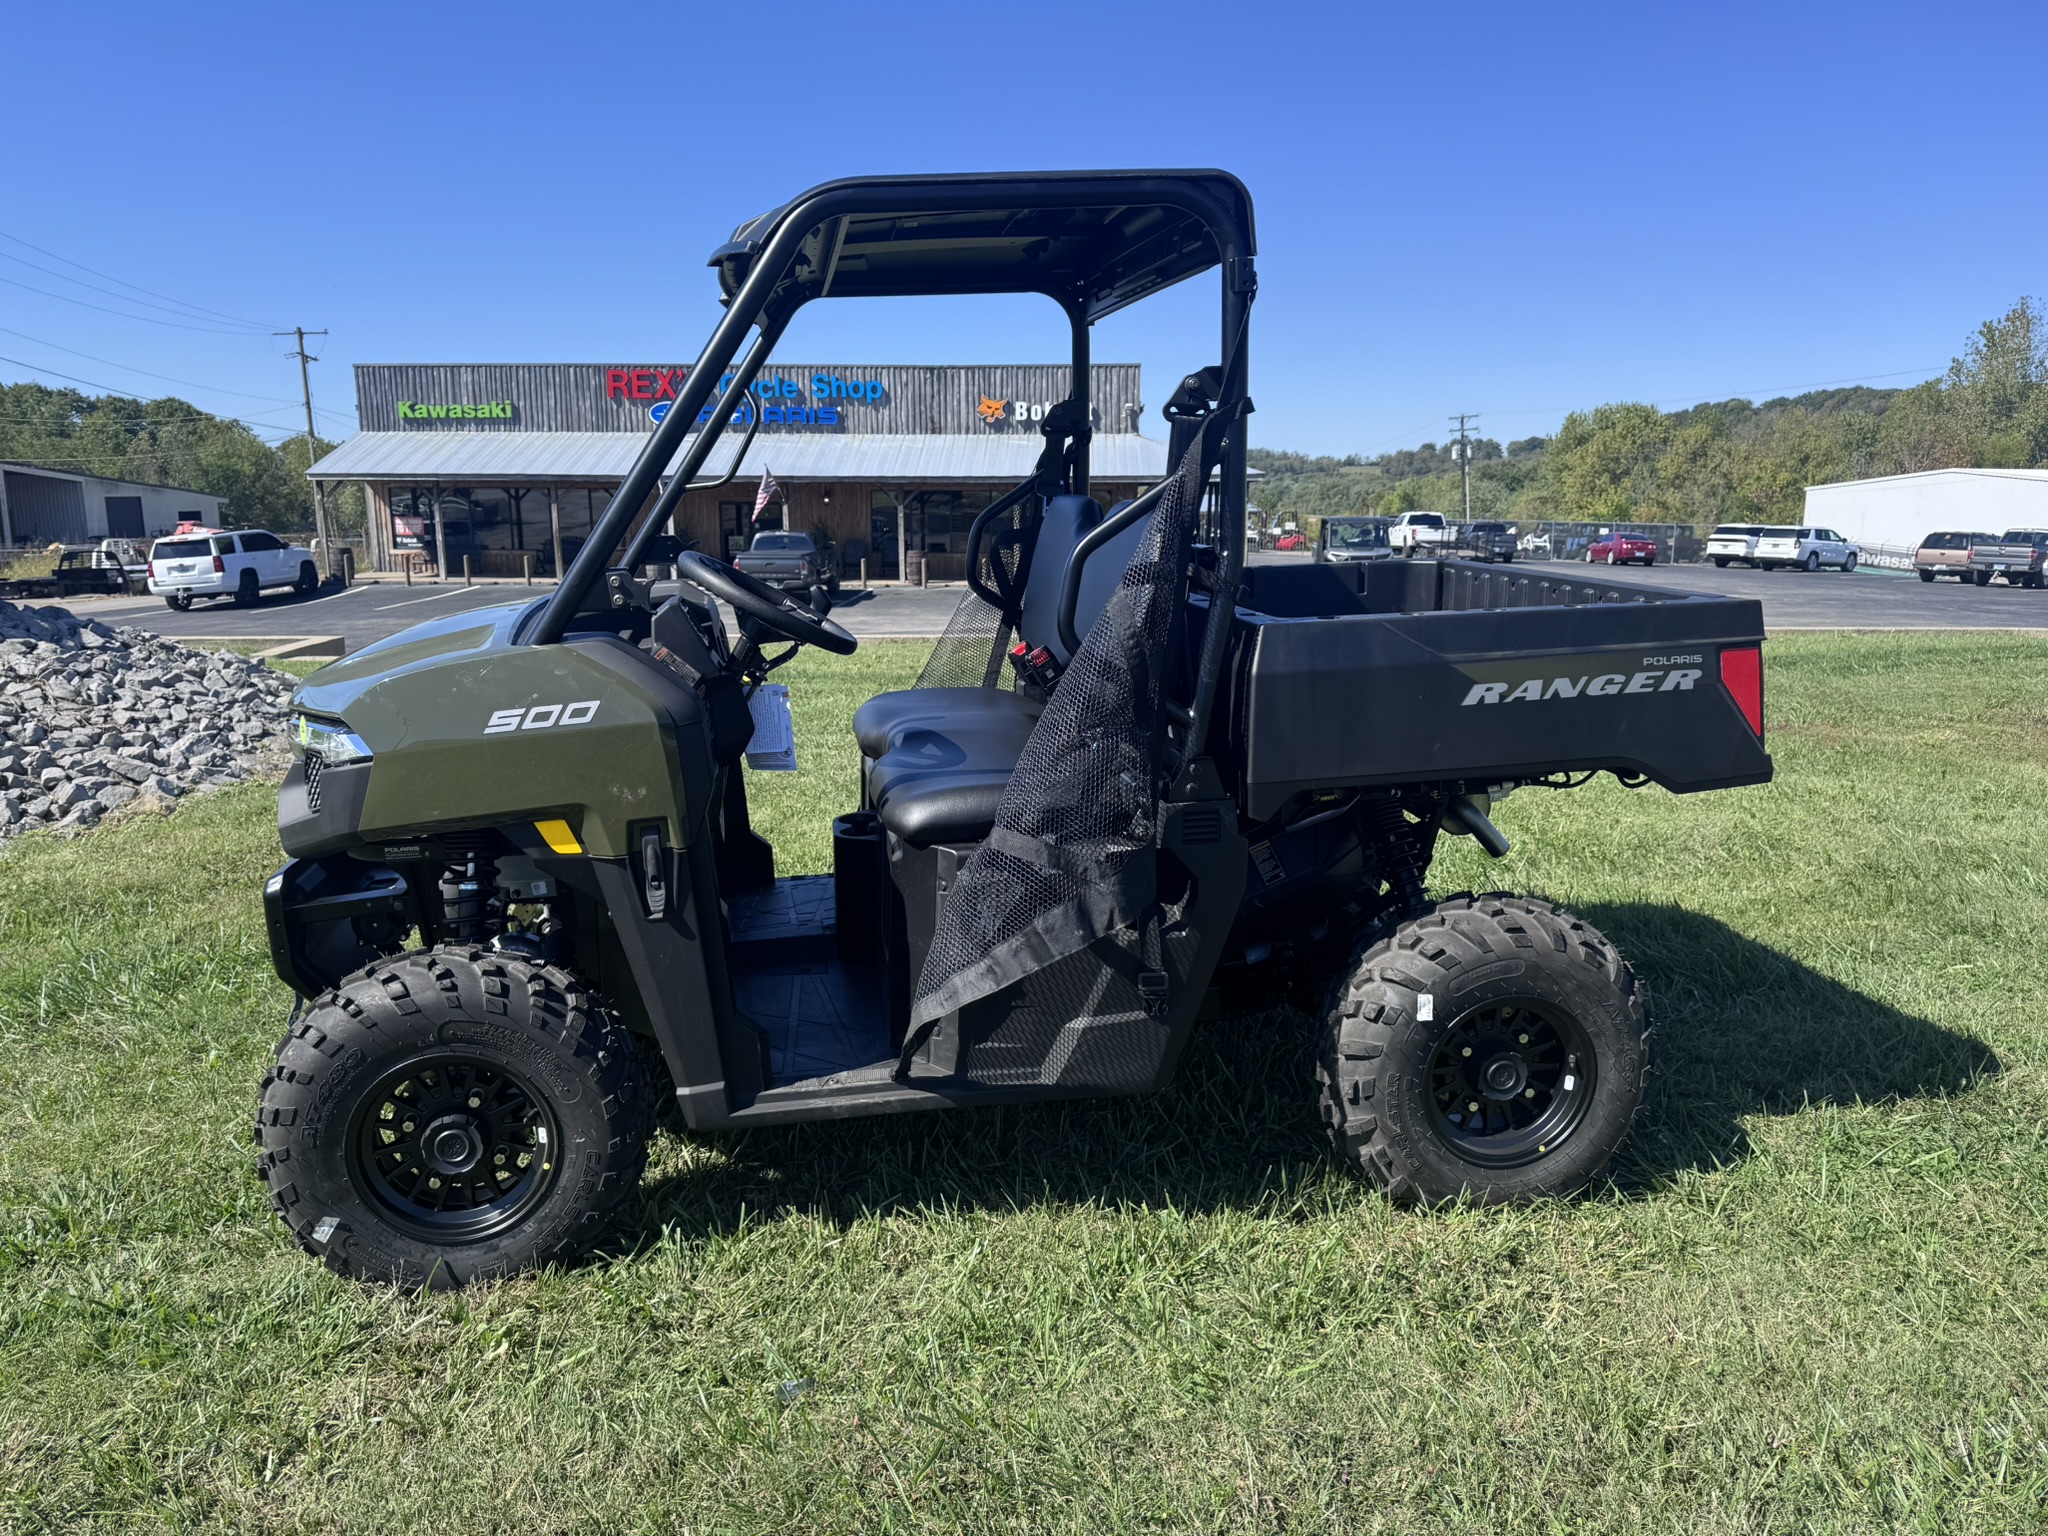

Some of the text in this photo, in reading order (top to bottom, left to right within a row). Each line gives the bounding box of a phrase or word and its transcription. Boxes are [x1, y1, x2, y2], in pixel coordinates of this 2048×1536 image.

[606, 369, 883, 403] REX' Ccle Shop
[397, 400, 513, 419] Kawasaki
[1643, 654, 1703, 666] POLARIS
[1460, 668, 1703, 706] RANGER
[482, 700, 601, 735] 500
[384, 845, 420, 853] POLARIS
[1385, 1072, 1424, 1171] CARLSTAR
[531, 1150, 600, 1252] CARLSTAR
